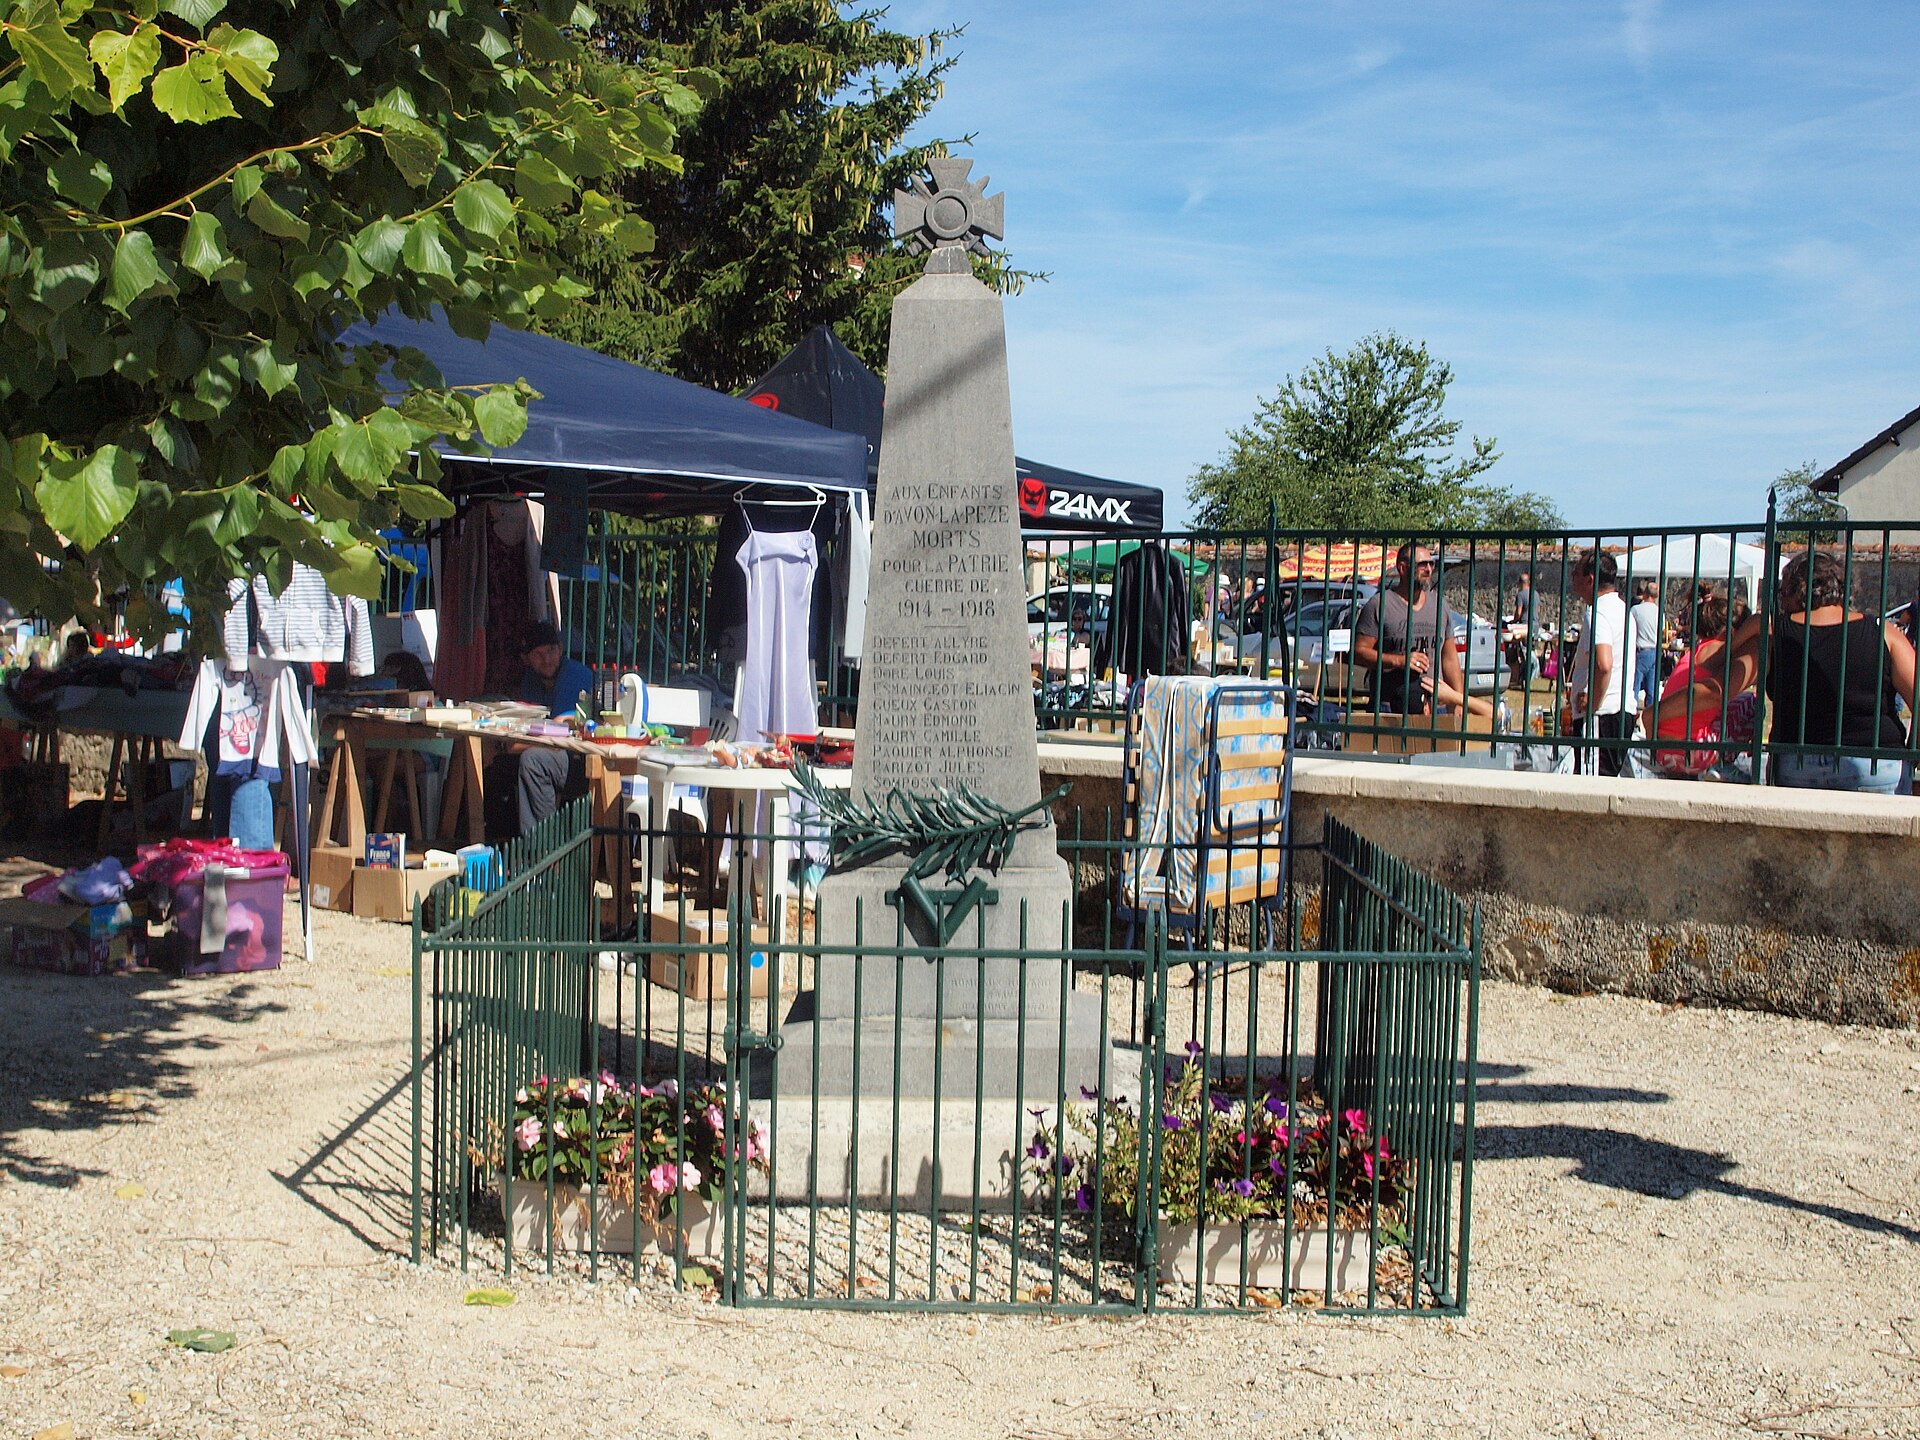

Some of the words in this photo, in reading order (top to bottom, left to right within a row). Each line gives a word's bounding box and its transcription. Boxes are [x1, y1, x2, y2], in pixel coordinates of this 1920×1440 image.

[891, 485, 921, 500] AUX
[928, 483, 1003, 500] ENFANTS
[1049, 490, 1133, 525] 24MX
[912, 530, 982, 549] MORTS
[882, 559, 921, 573] POUR
[924, 560, 944, 573] LA
[948, 554, 1009, 573] PATRIE
[904, 578, 964, 593] GUERRE
[970, 578, 990, 593] DE
[898, 599, 933, 618] 1914
[961, 598, 995, 618] 1918
[872, 636, 929, 649] DEFERT
[934, 636, 988, 649] ALLYRE
[872, 652, 929, 665] DEFERT
[934, 652, 988, 665] EDGARD
[915, 666, 955, 680] LOUIS
[965, 682, 1021, 696] ELIACIN
[923, 698, 977, 712] GASTON
[872, 713, 917, 727] MAURY
[923, 713, 977, 727] EDMOND
[872, 729, 917, 743] MAURY
[923, 729, 981, 743] CAMILLE
[939, 745, 1013, 758] ALPHONSE
[872, 760, 932, 774] PARIZOT
[938, 760, 986, 774] JULES
